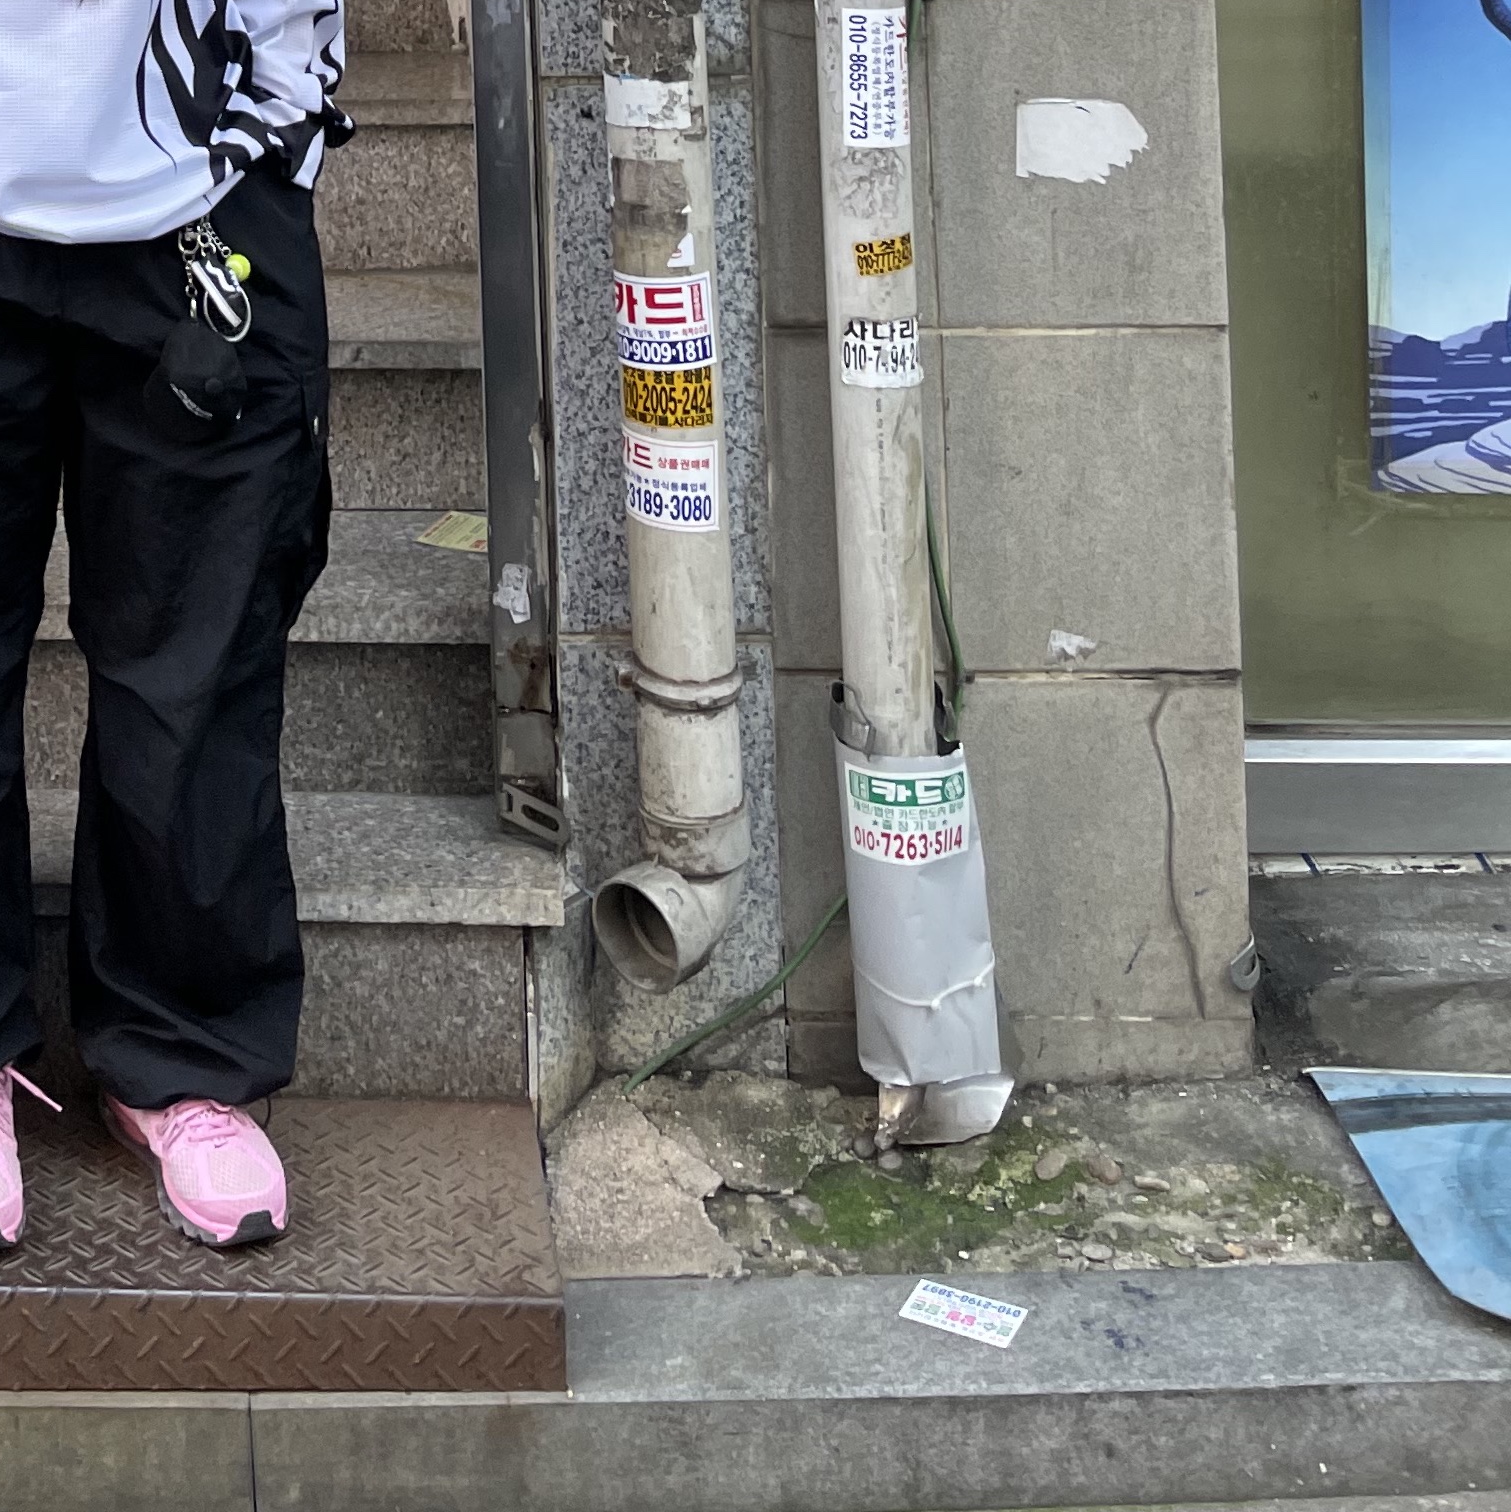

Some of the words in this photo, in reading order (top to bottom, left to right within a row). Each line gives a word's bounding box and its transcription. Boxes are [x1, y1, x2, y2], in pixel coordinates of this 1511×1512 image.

[848, 15, 868, 140] 010-8655-7273
[615, 280, 687, 324] 카드
[871, 778, 943, 805] 카드
